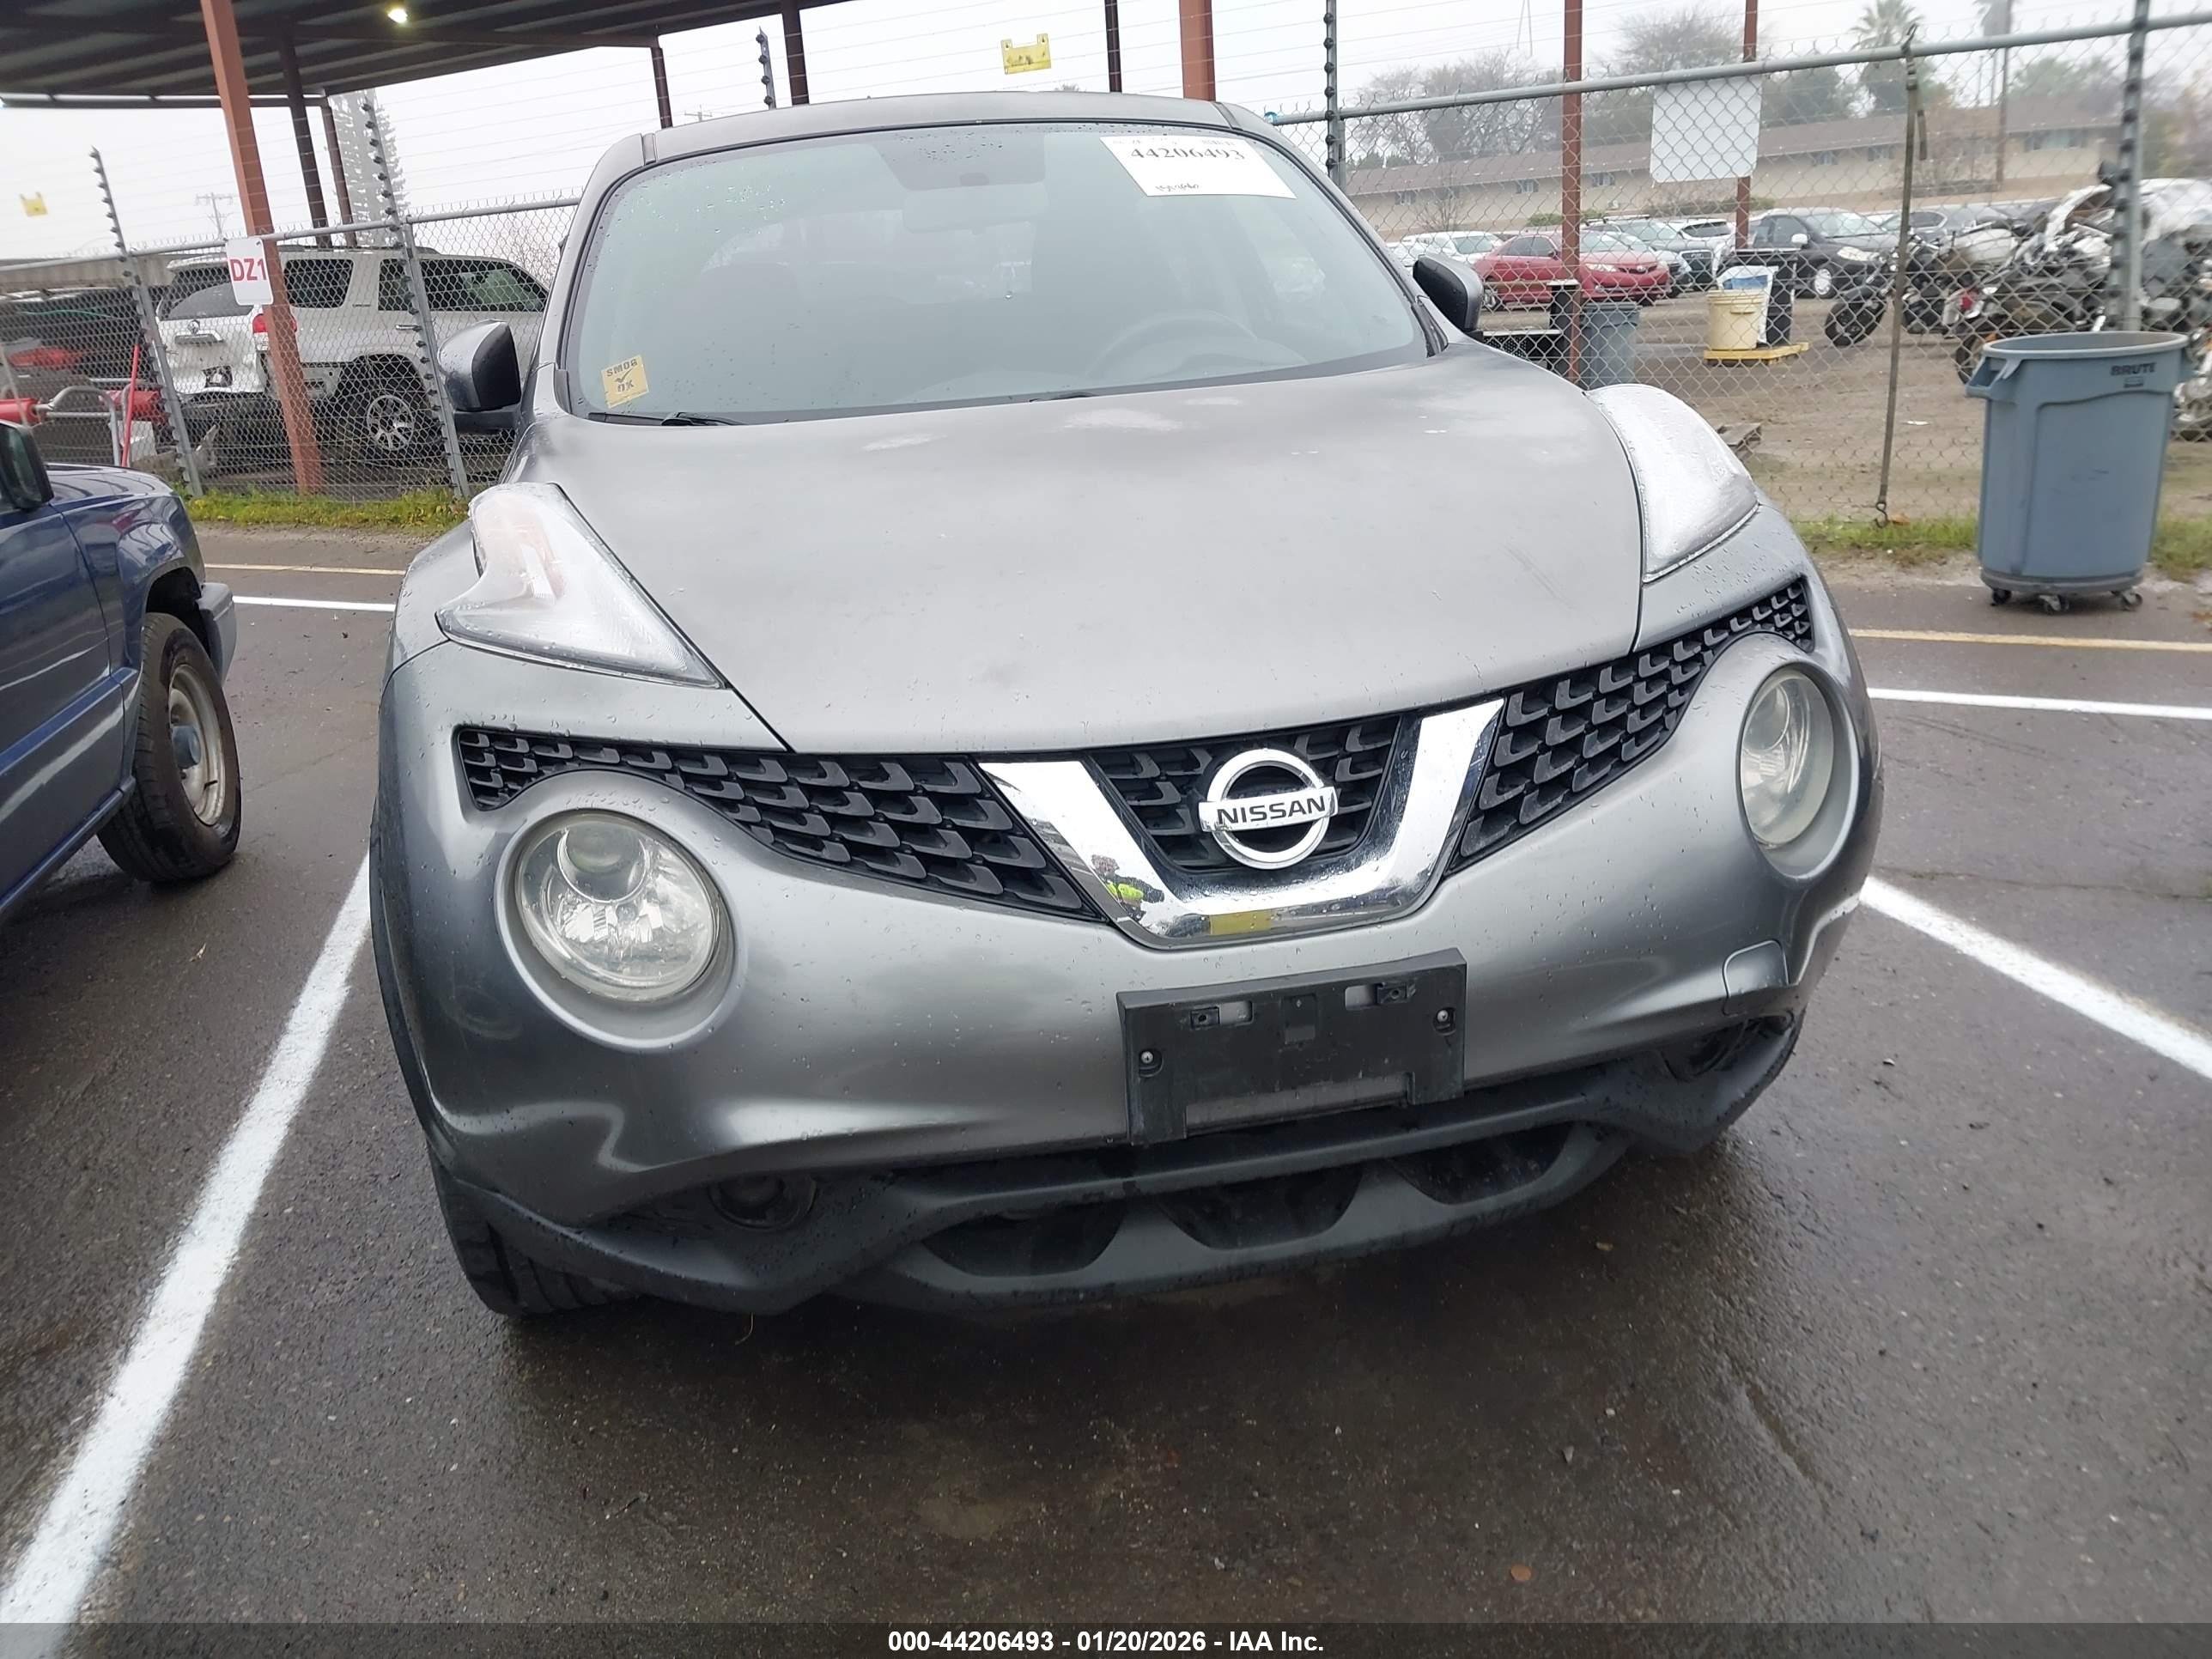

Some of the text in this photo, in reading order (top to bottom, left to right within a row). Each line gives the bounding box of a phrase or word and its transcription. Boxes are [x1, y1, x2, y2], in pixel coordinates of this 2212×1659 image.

[1131, 148, 1245, 160] 44206493
[229, 258, 267, 282] DZ1
[606, 358, 638, 377] SMOG
[1217, 795, 1326, 825] NISSAN
